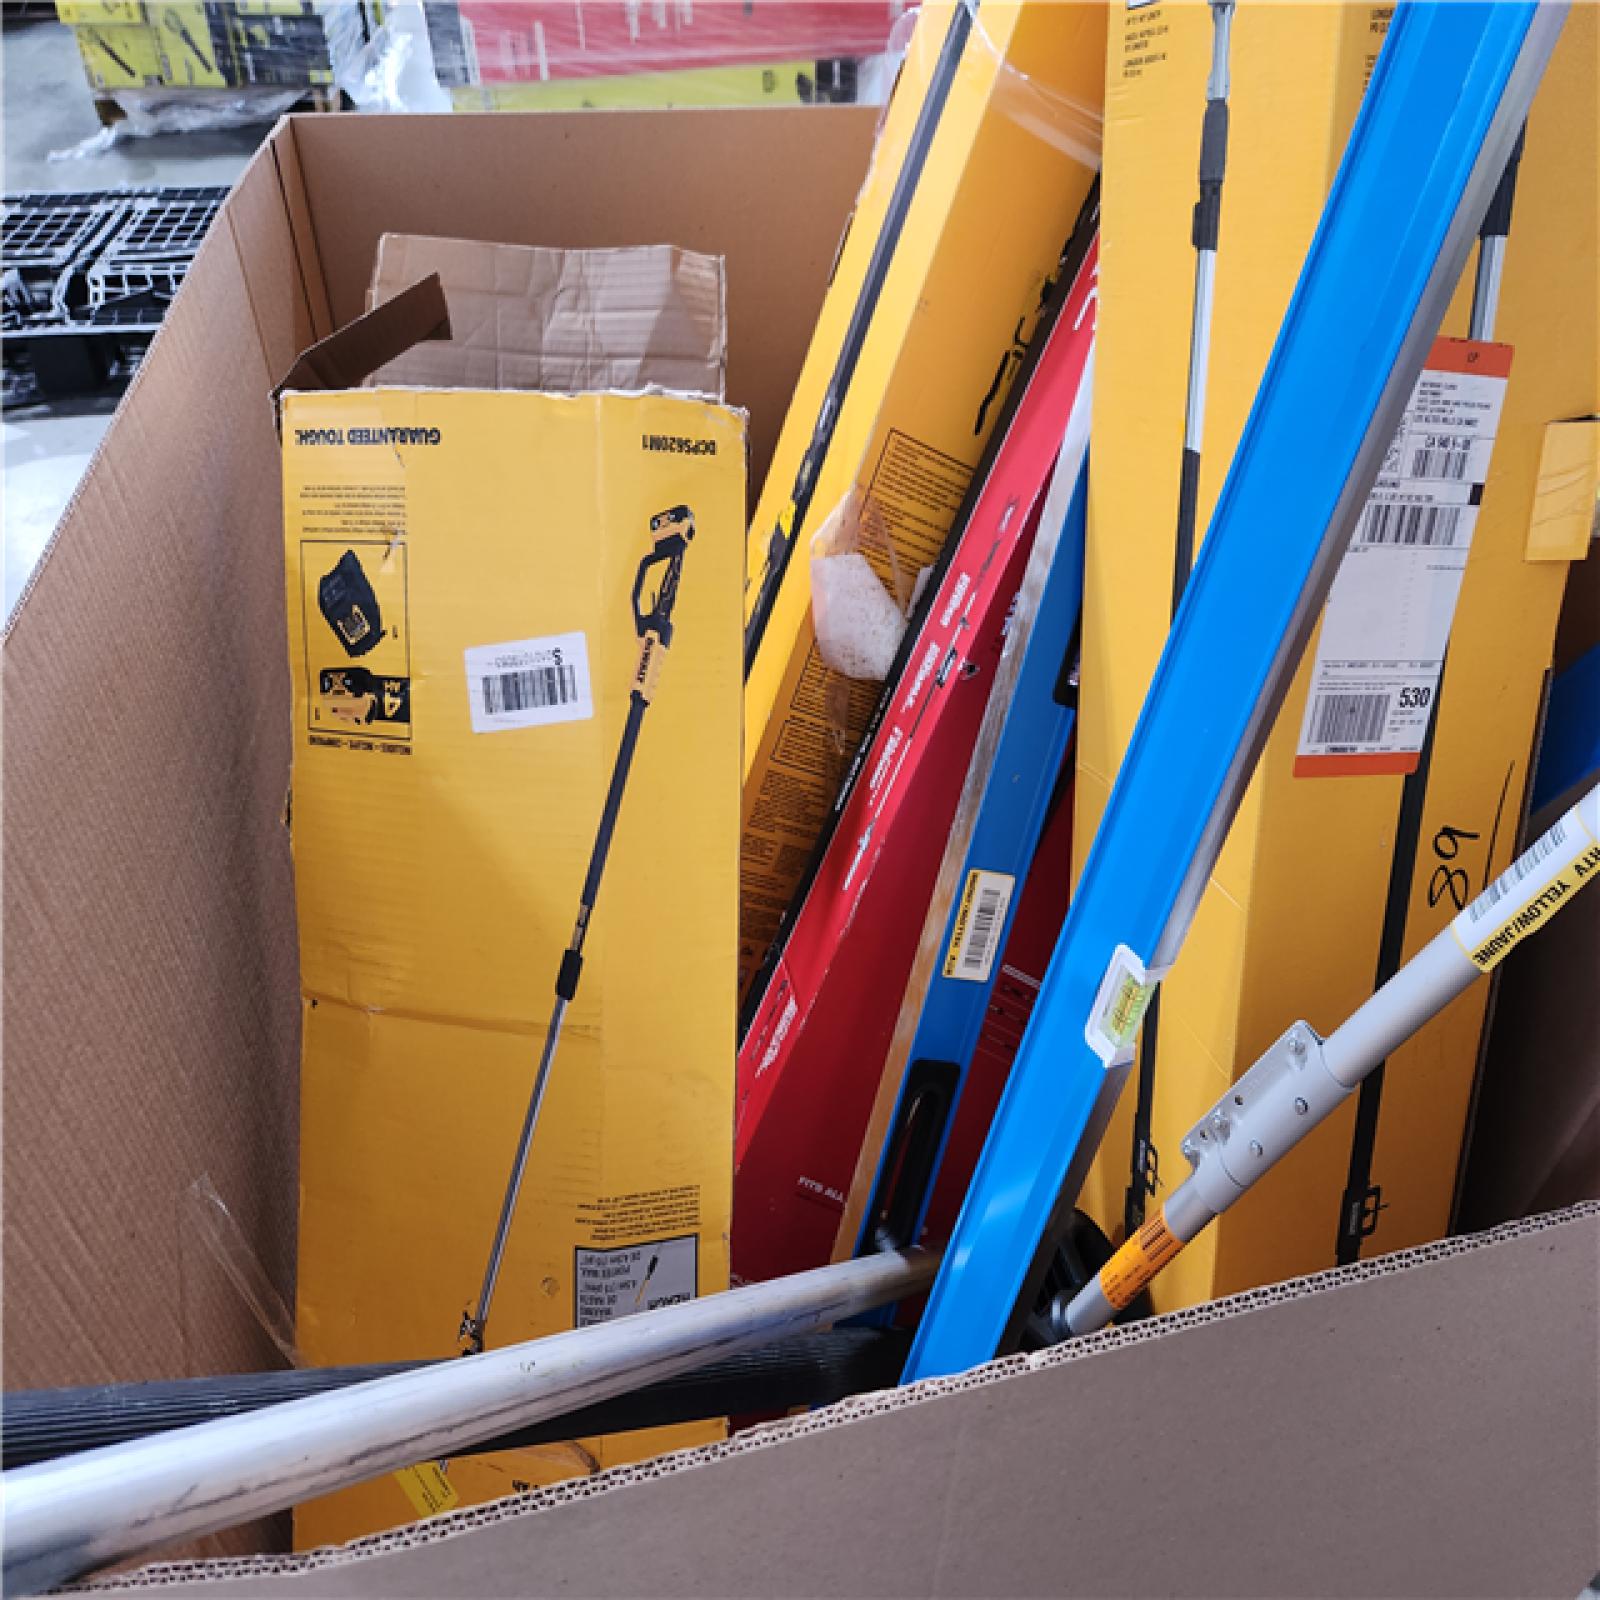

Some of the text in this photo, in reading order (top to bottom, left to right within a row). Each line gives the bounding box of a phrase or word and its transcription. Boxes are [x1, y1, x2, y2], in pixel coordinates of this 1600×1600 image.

[348, 427, 441, 447] GUARANTEED
[642, 434, 717, 456] DCPS620M1
[383, 695, 401, 718] 4
[1399, 686, 1431, 708] 530
[1472, 881, 1571, 965] YELLOW/JAUNE
